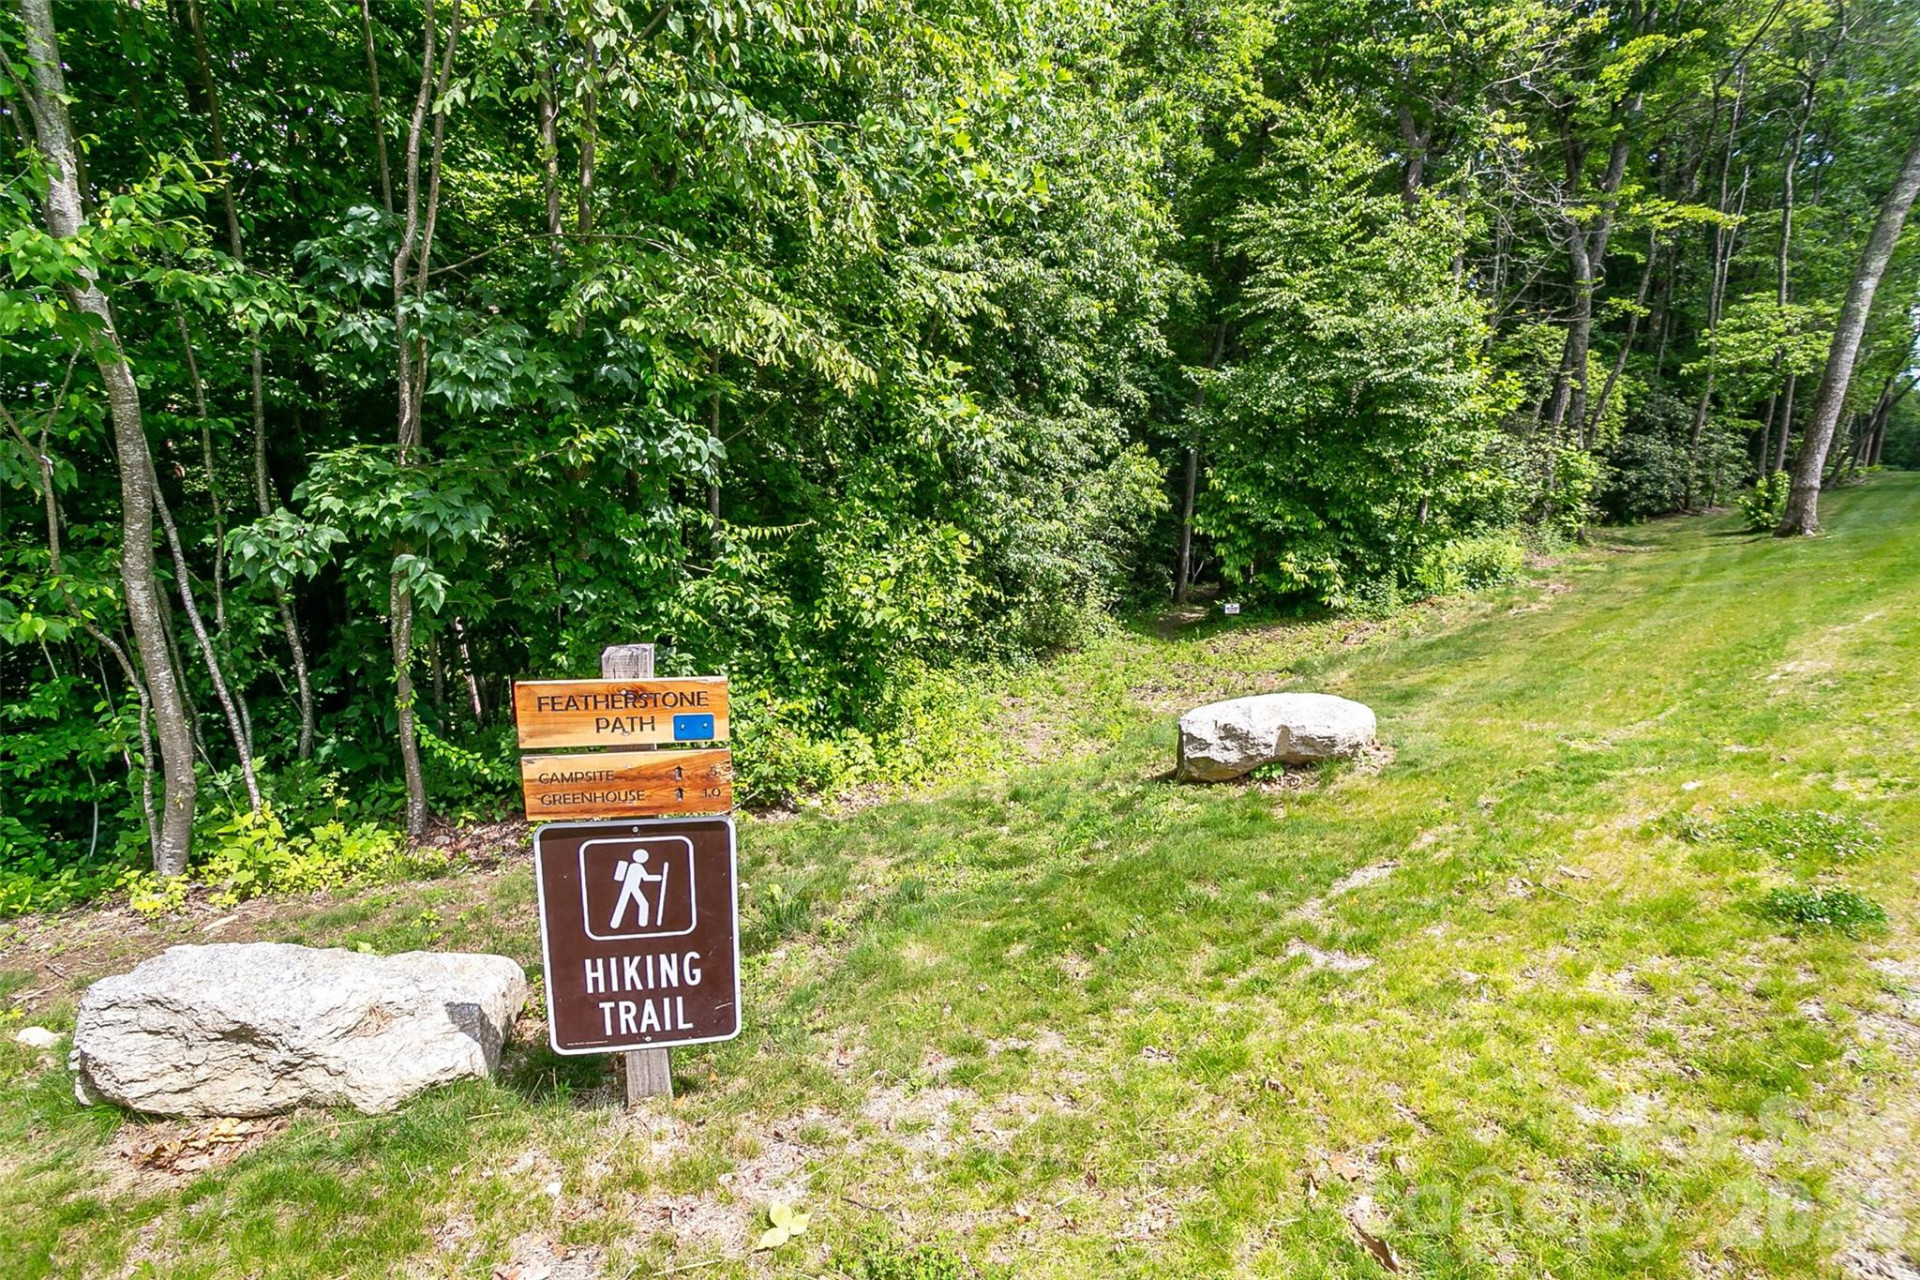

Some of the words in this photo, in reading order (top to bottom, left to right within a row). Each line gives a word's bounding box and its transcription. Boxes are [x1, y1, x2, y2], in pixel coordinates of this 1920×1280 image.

[536, 689, 709, 713] FEATHERSTONE
[595, 715, 656, 734] PATH
[538, 769, 615, 785] CAMPSITE
[540, 789, 646, 806] GREENHOUSE
[702, 787, 721, 798] 1.0
[584, 951, 702, 994] HIKING
[598, 996, 694, 1036] TRAIL
